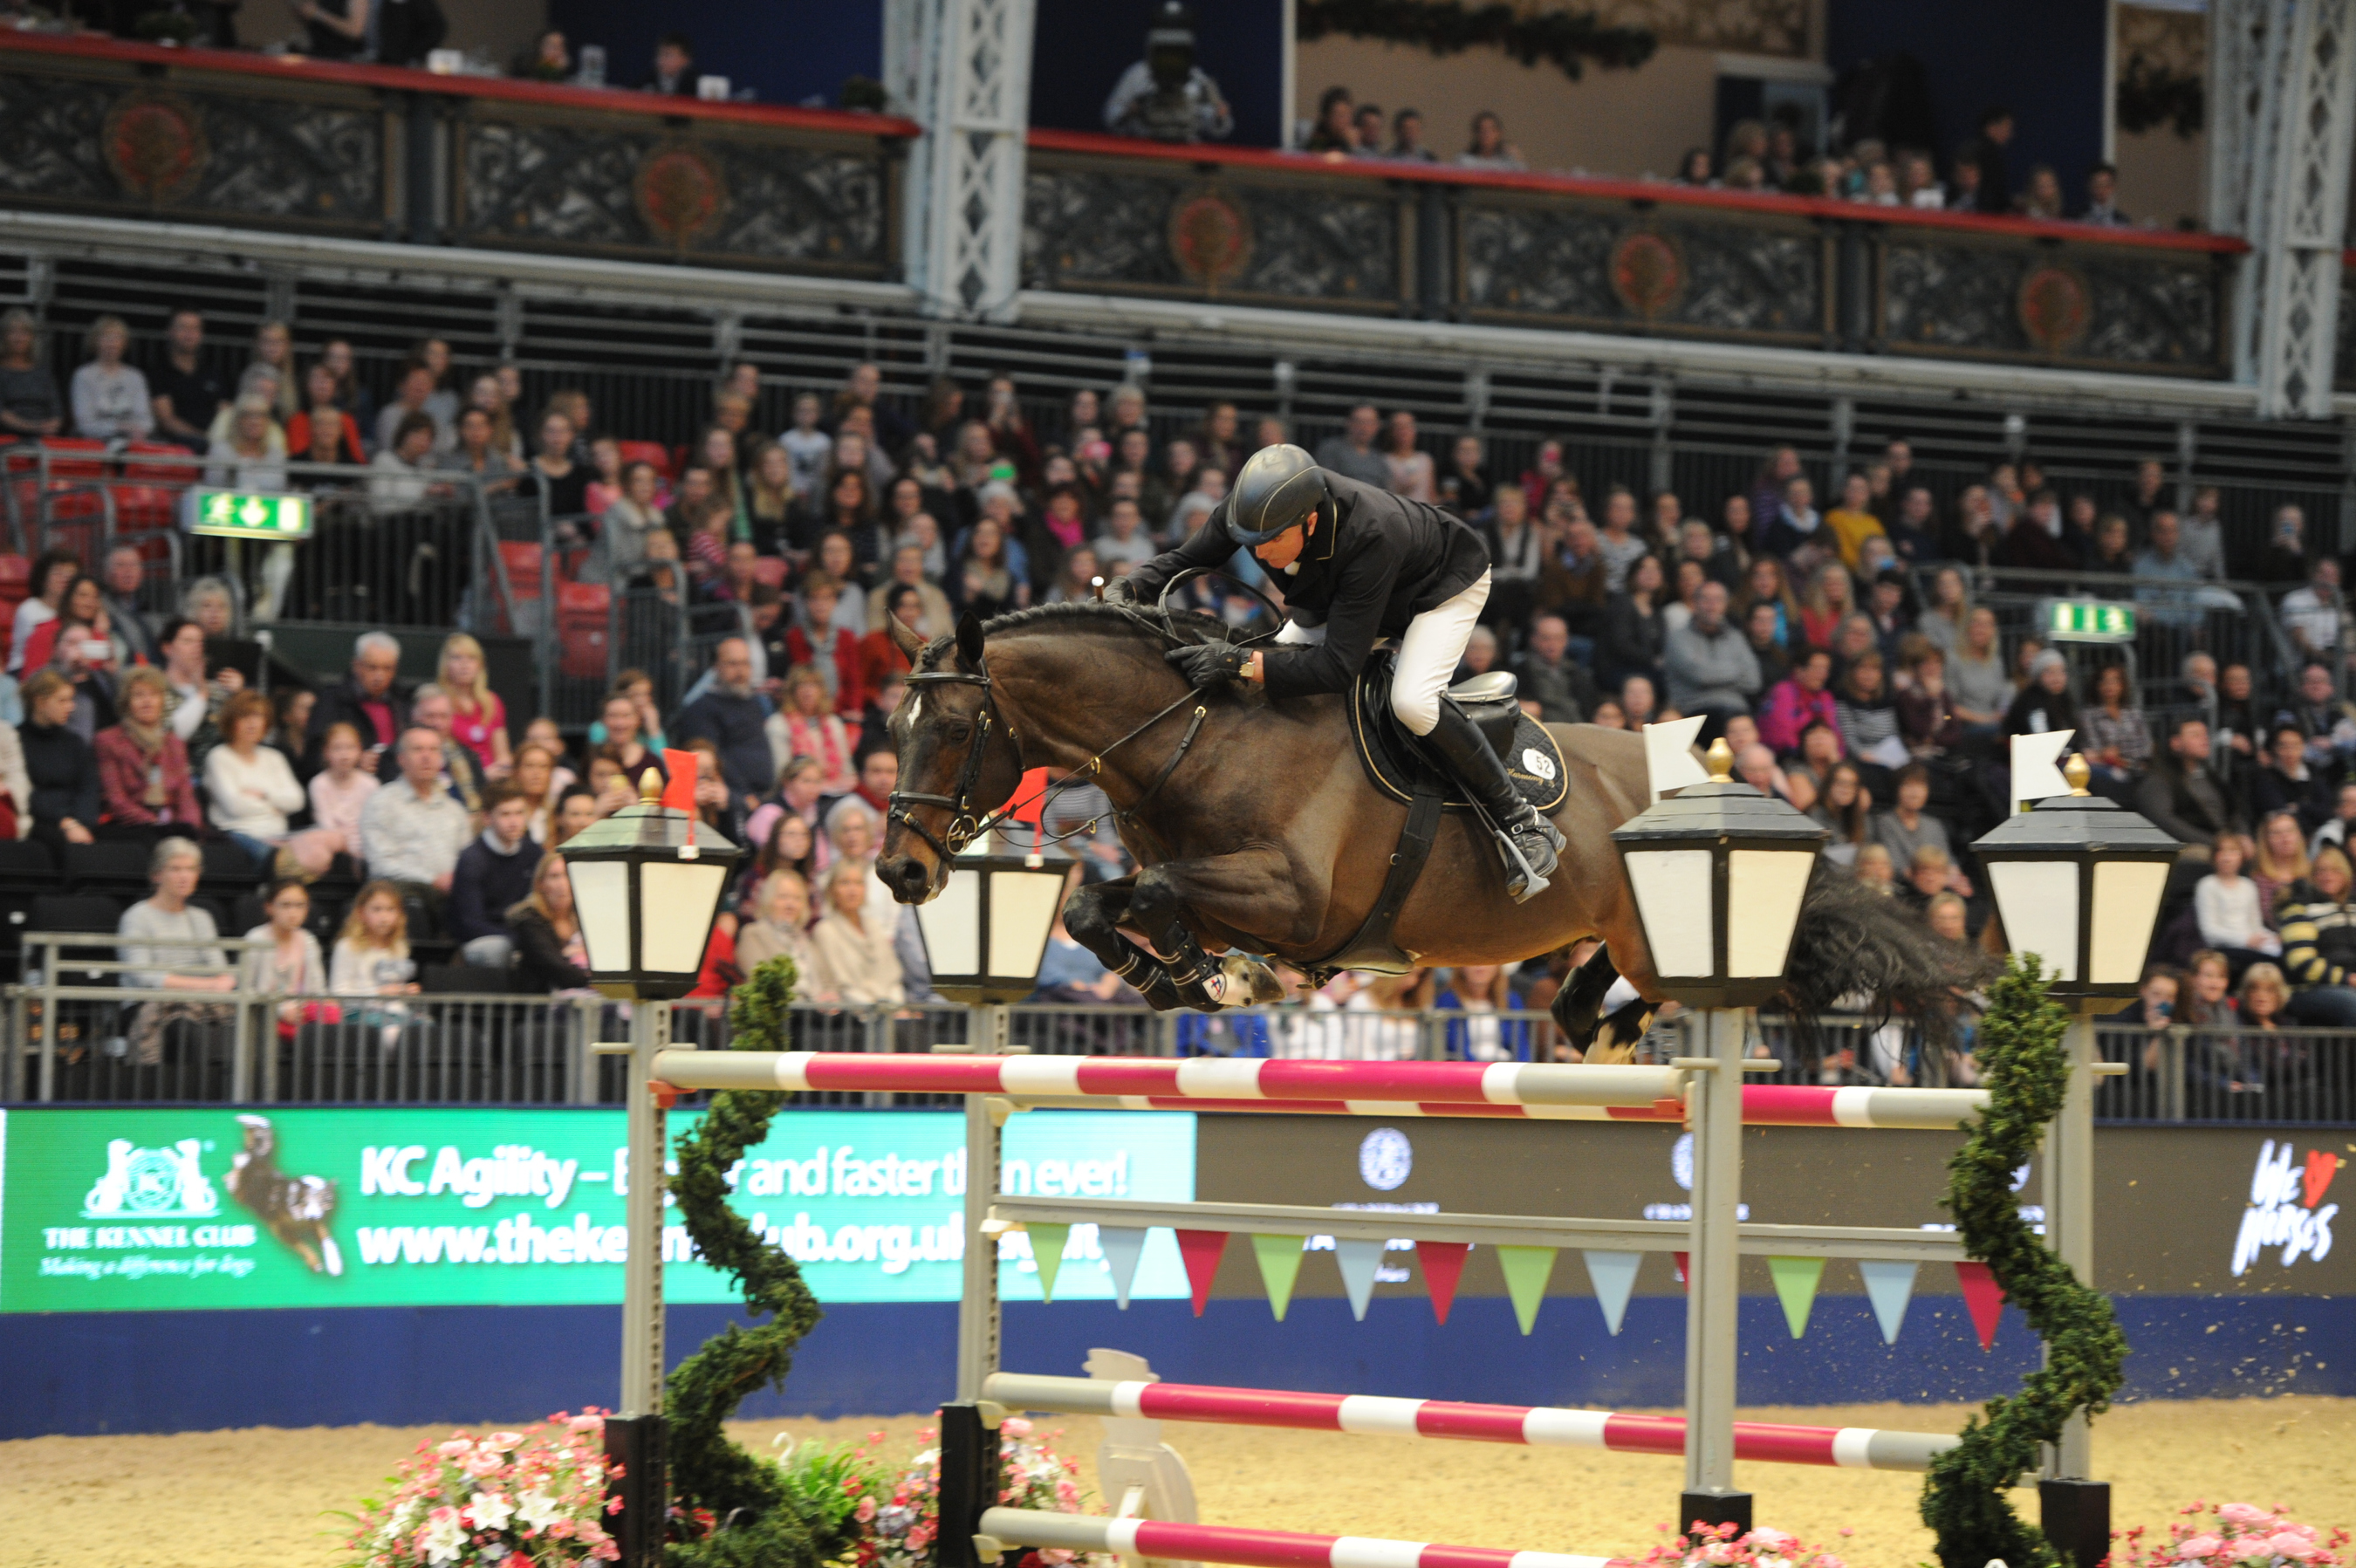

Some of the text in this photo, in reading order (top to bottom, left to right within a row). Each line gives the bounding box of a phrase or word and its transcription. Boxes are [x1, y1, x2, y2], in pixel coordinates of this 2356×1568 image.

[1536, 756, 1551, 774] 52
[360, 1145, 427, 1196] KC
[748, 1146, 828, 1196] and
[832, 1145, 941, 1196] faster
[942, 1147, 1032, 1196] tn
[1035, 1149, 1128, 1196] ever!
[43, 1224, 257, 1250] THE KENNEL CLUB
